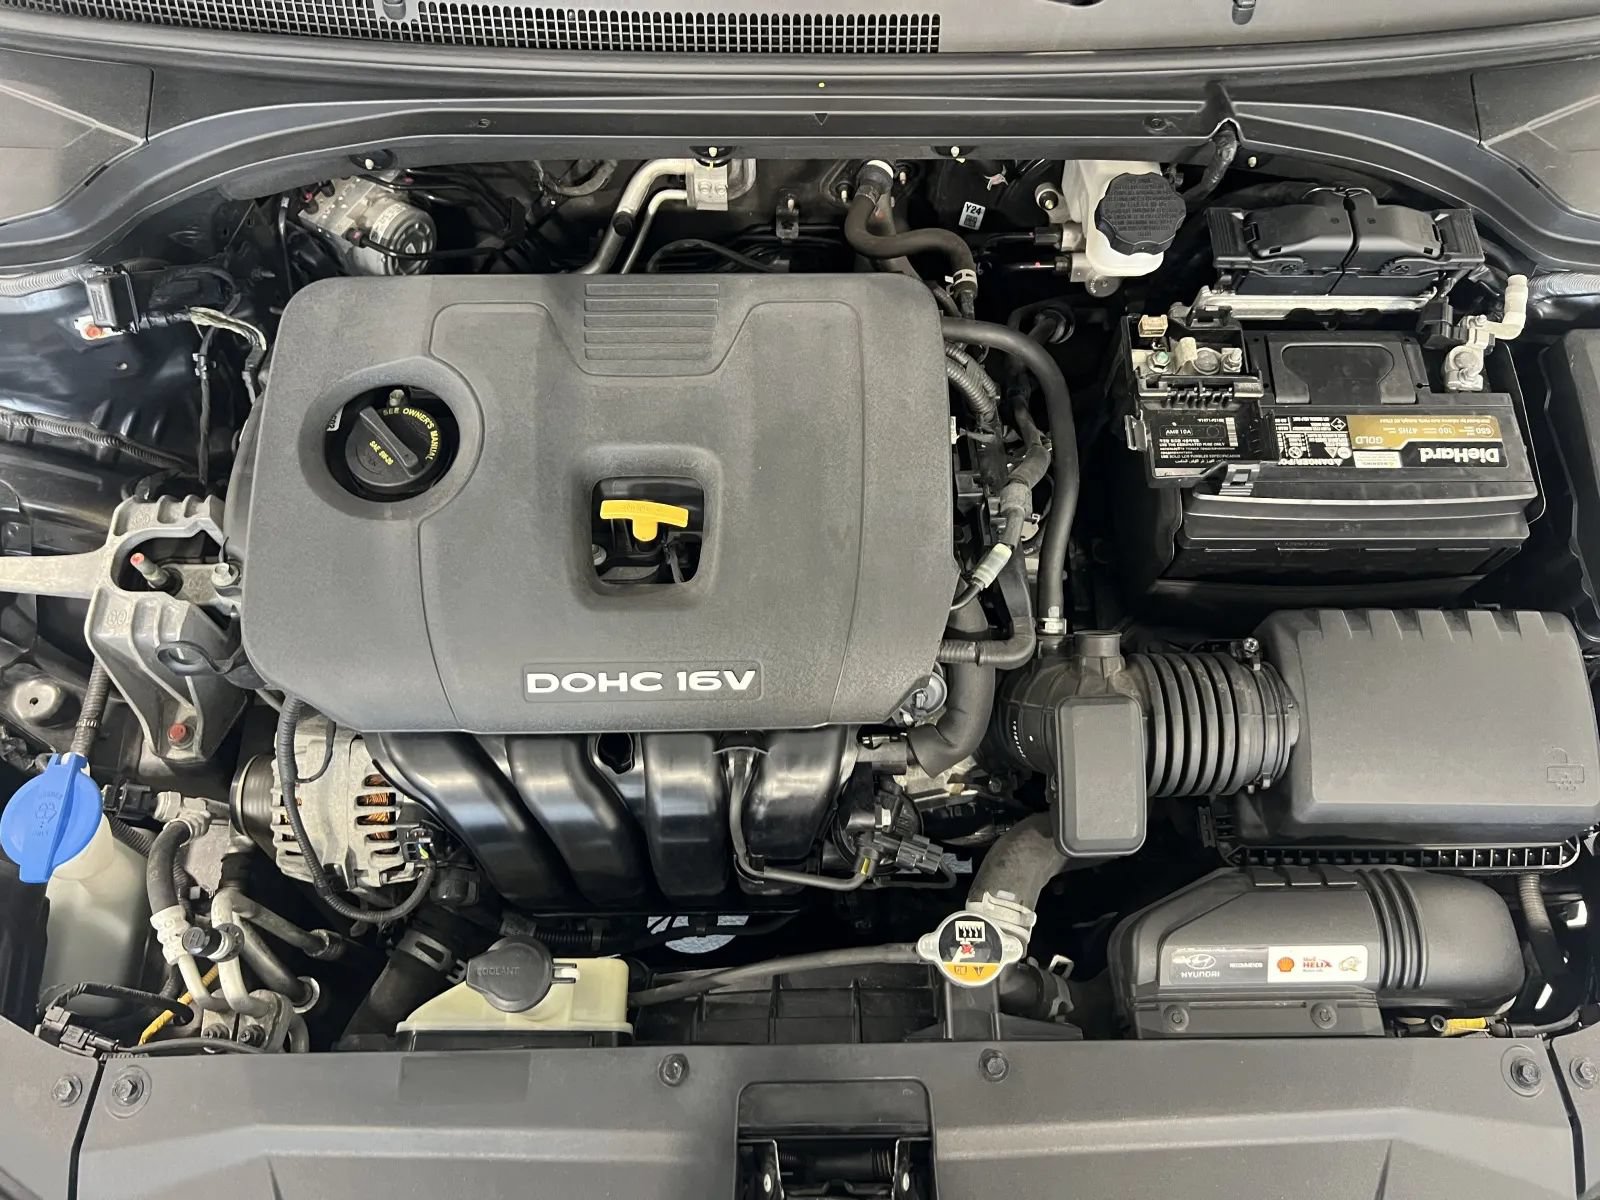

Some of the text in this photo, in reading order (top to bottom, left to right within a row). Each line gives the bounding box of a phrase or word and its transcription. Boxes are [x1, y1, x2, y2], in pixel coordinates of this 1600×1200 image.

[966, 204, 982, 215] Y24
[383, 407, 438, 460] SEE OWNER'S MANUAL
[1355, 436, 1383, 445] GOLD
[369, 441, 381, 453] SAE
[1420, 447, 1499, 463] DieHard
[526, 670, 756, 693] DOHC 16V
[1303, 960, 1332, 968] HELIX
